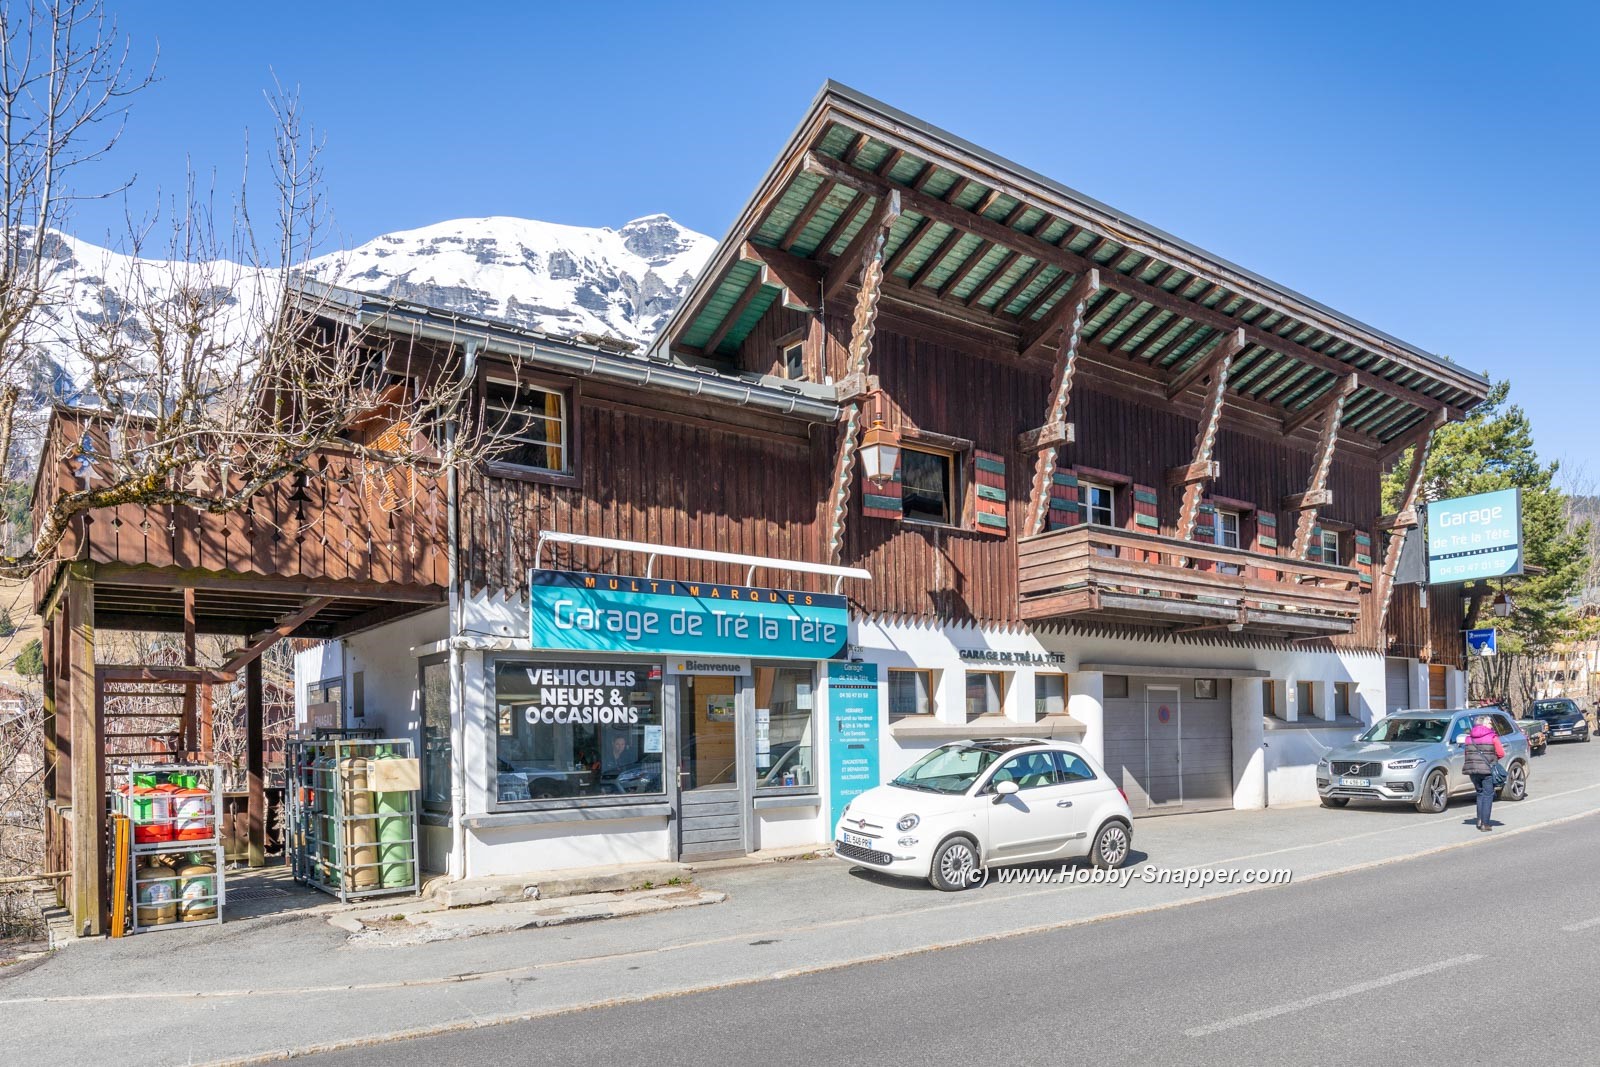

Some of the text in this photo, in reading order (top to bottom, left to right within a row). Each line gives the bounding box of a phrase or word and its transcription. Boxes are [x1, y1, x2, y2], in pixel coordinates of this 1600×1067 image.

[1440, 506, 1502, 527] Garage
[1433, 537, 1447, 549] de
[1471, 531, 1481, 543] la
[585, 577, 813, 605] MULTIMARQUES
[554, 599, 836, 643] Garage de Tré la Tête
[959, 649, 998, 660] GARAGE
[1000, 651, 1012, 661] DE
[1032, 653, 1044, 663] LA
[685, 660, 741, 672] Bienvenue
[843, 663, 863, 673] Garage
[525, 668, 636, 687] VEHICULES
[540, 687, 624, 706] NEUFS &
[525, 706, 639, 724] OCCASIONS
